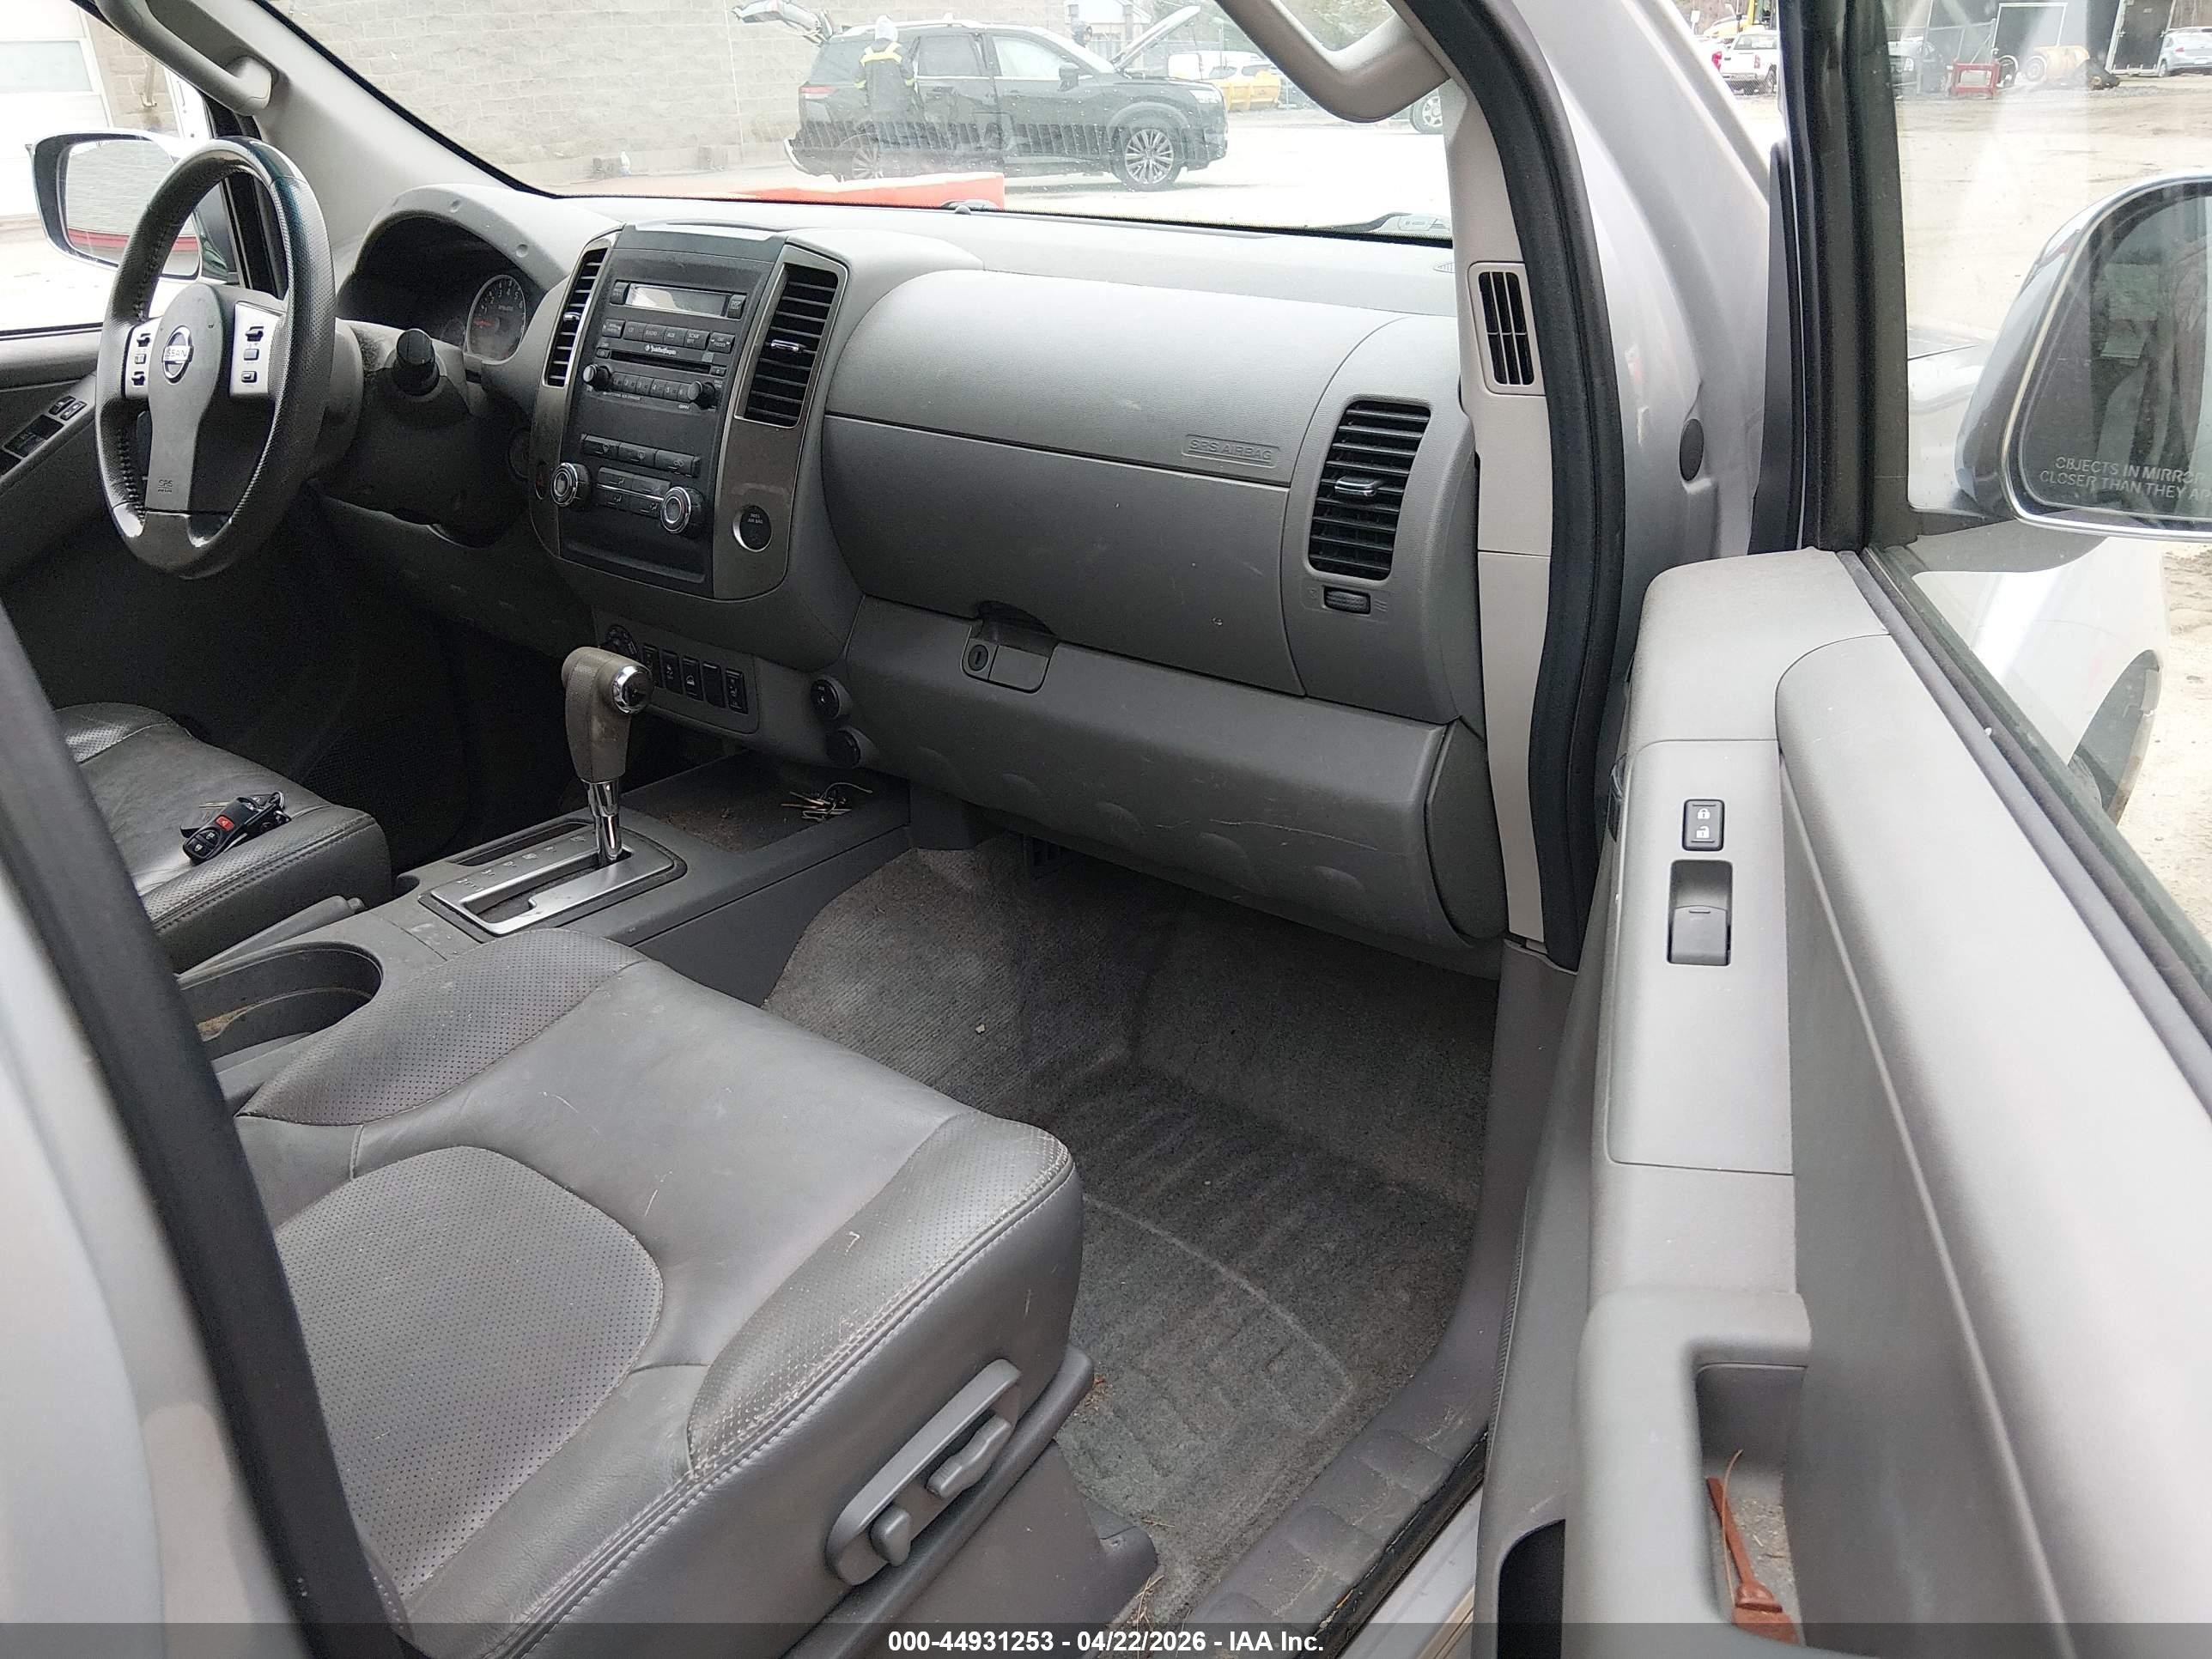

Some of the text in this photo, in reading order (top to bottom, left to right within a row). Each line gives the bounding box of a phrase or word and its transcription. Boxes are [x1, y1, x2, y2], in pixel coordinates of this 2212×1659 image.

[1190, 439, 1273, 460] SRS AIRBAG
[2055, 457, 2119, 476] OBJECTS
[2122, 465, 2141, 477] IN
[2039, 470, 2098, 489] CLOSER
[2101, 477, 2141, 494] THAN
[2144, 483, 2187, 499] THEY
